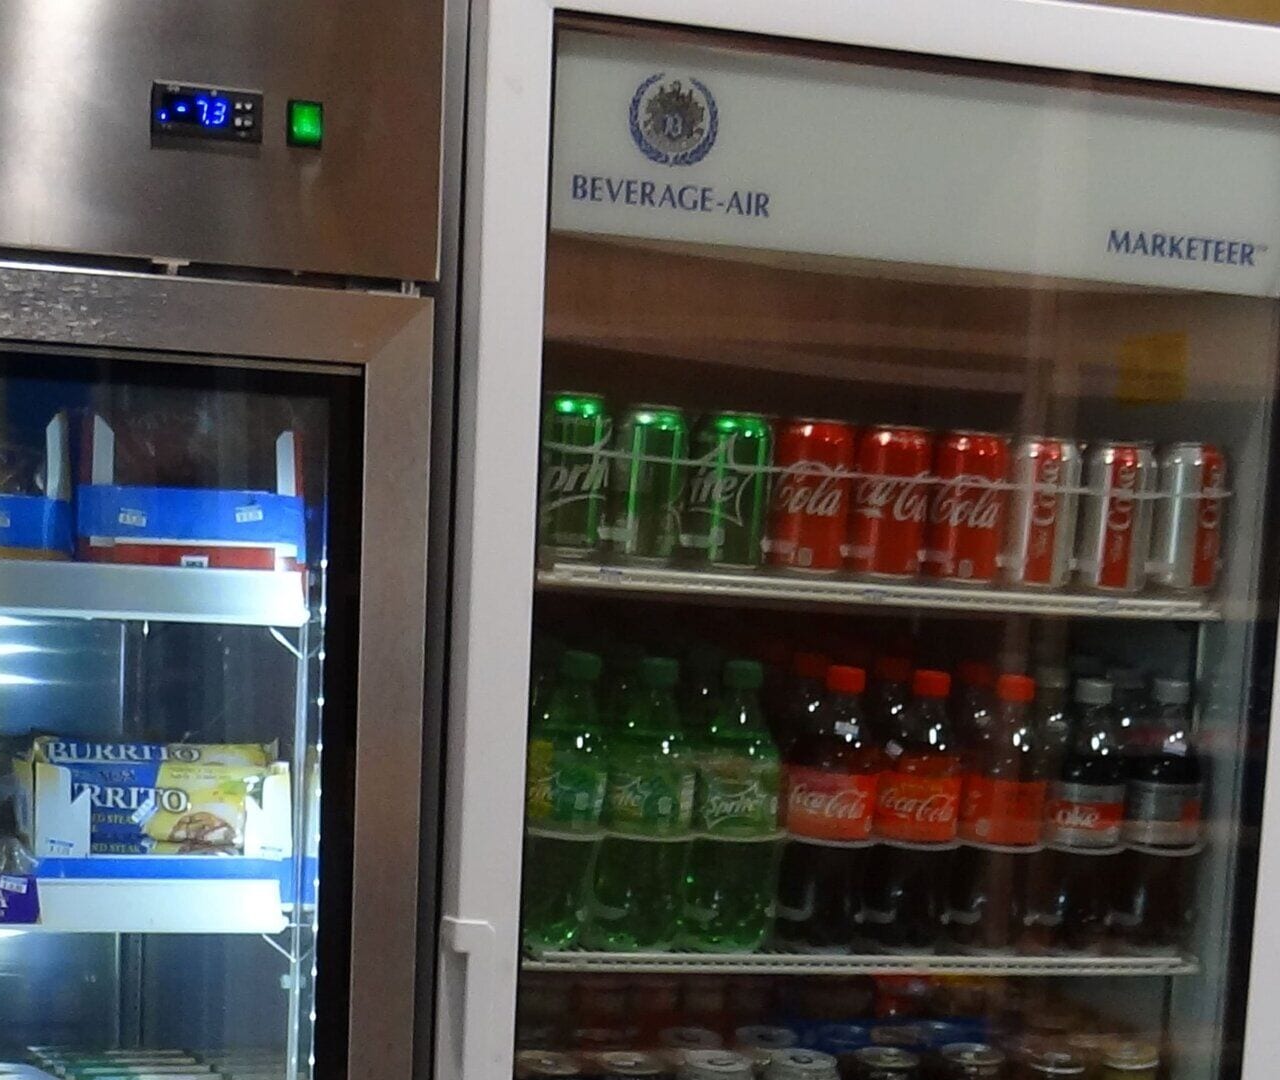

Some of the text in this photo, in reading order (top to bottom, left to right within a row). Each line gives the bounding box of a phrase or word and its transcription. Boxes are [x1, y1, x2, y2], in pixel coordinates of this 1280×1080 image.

[572, 174, 770, 218] BEVERAGE-AIR
[48, 742, 201, 762] BURRITO
[73, 782, 188, 813] RRITO
